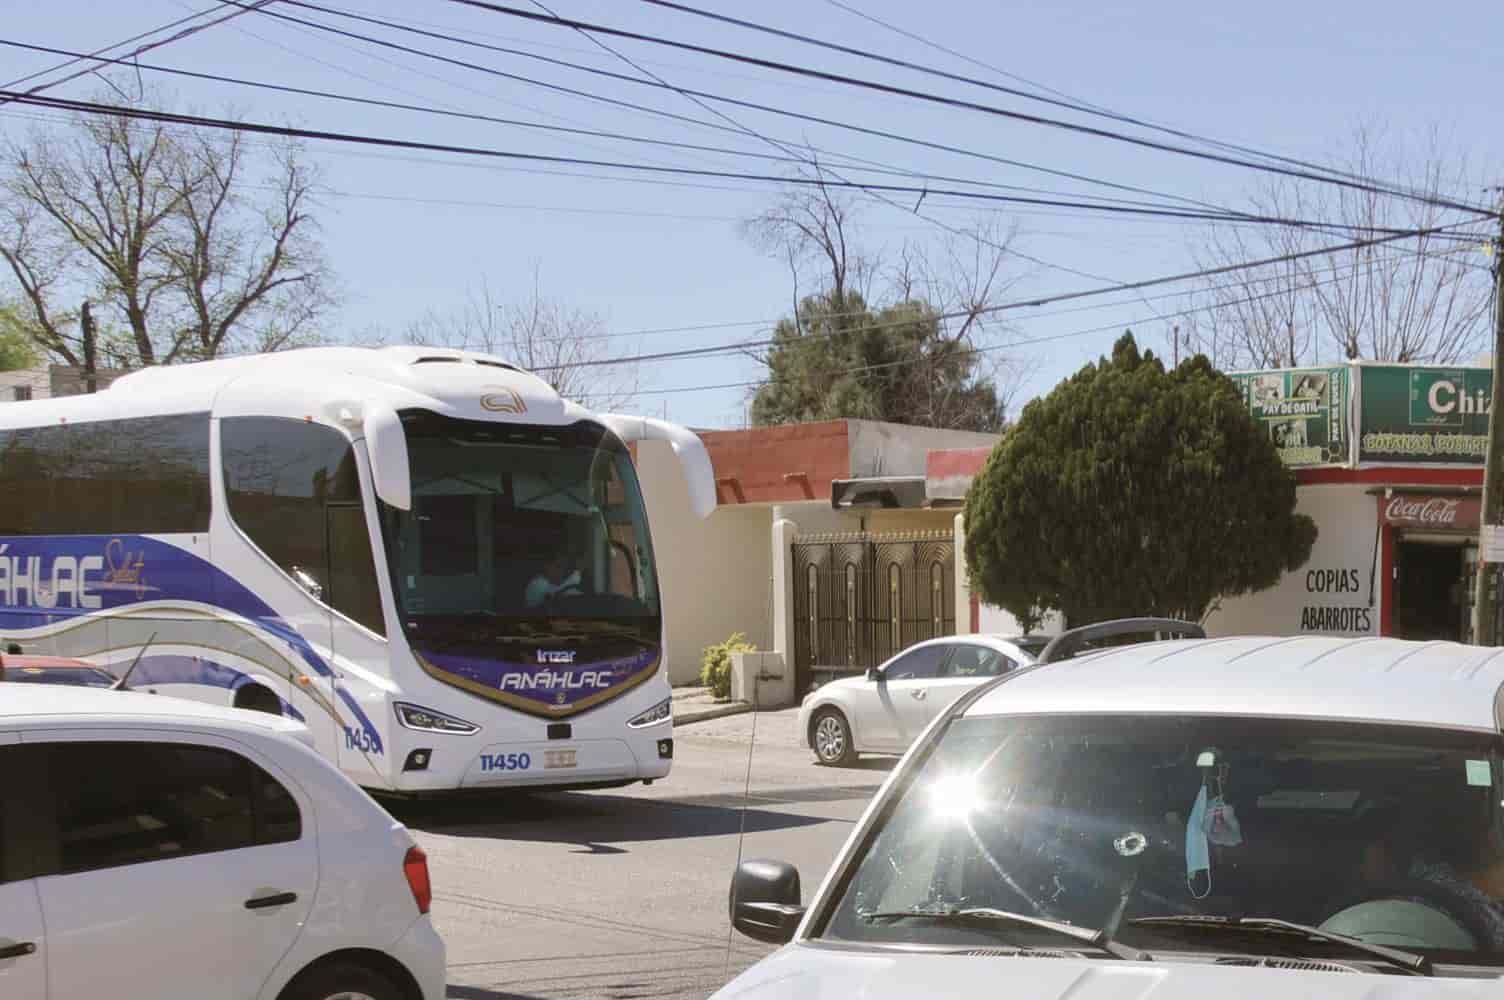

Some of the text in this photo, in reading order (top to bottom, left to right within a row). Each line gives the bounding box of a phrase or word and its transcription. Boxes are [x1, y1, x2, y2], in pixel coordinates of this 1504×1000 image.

[1306, 569, 1359, 593] COPIAS
[1301, 607, 1371, 631] ABARROTES
[480, 753, 531, 771] 11450
